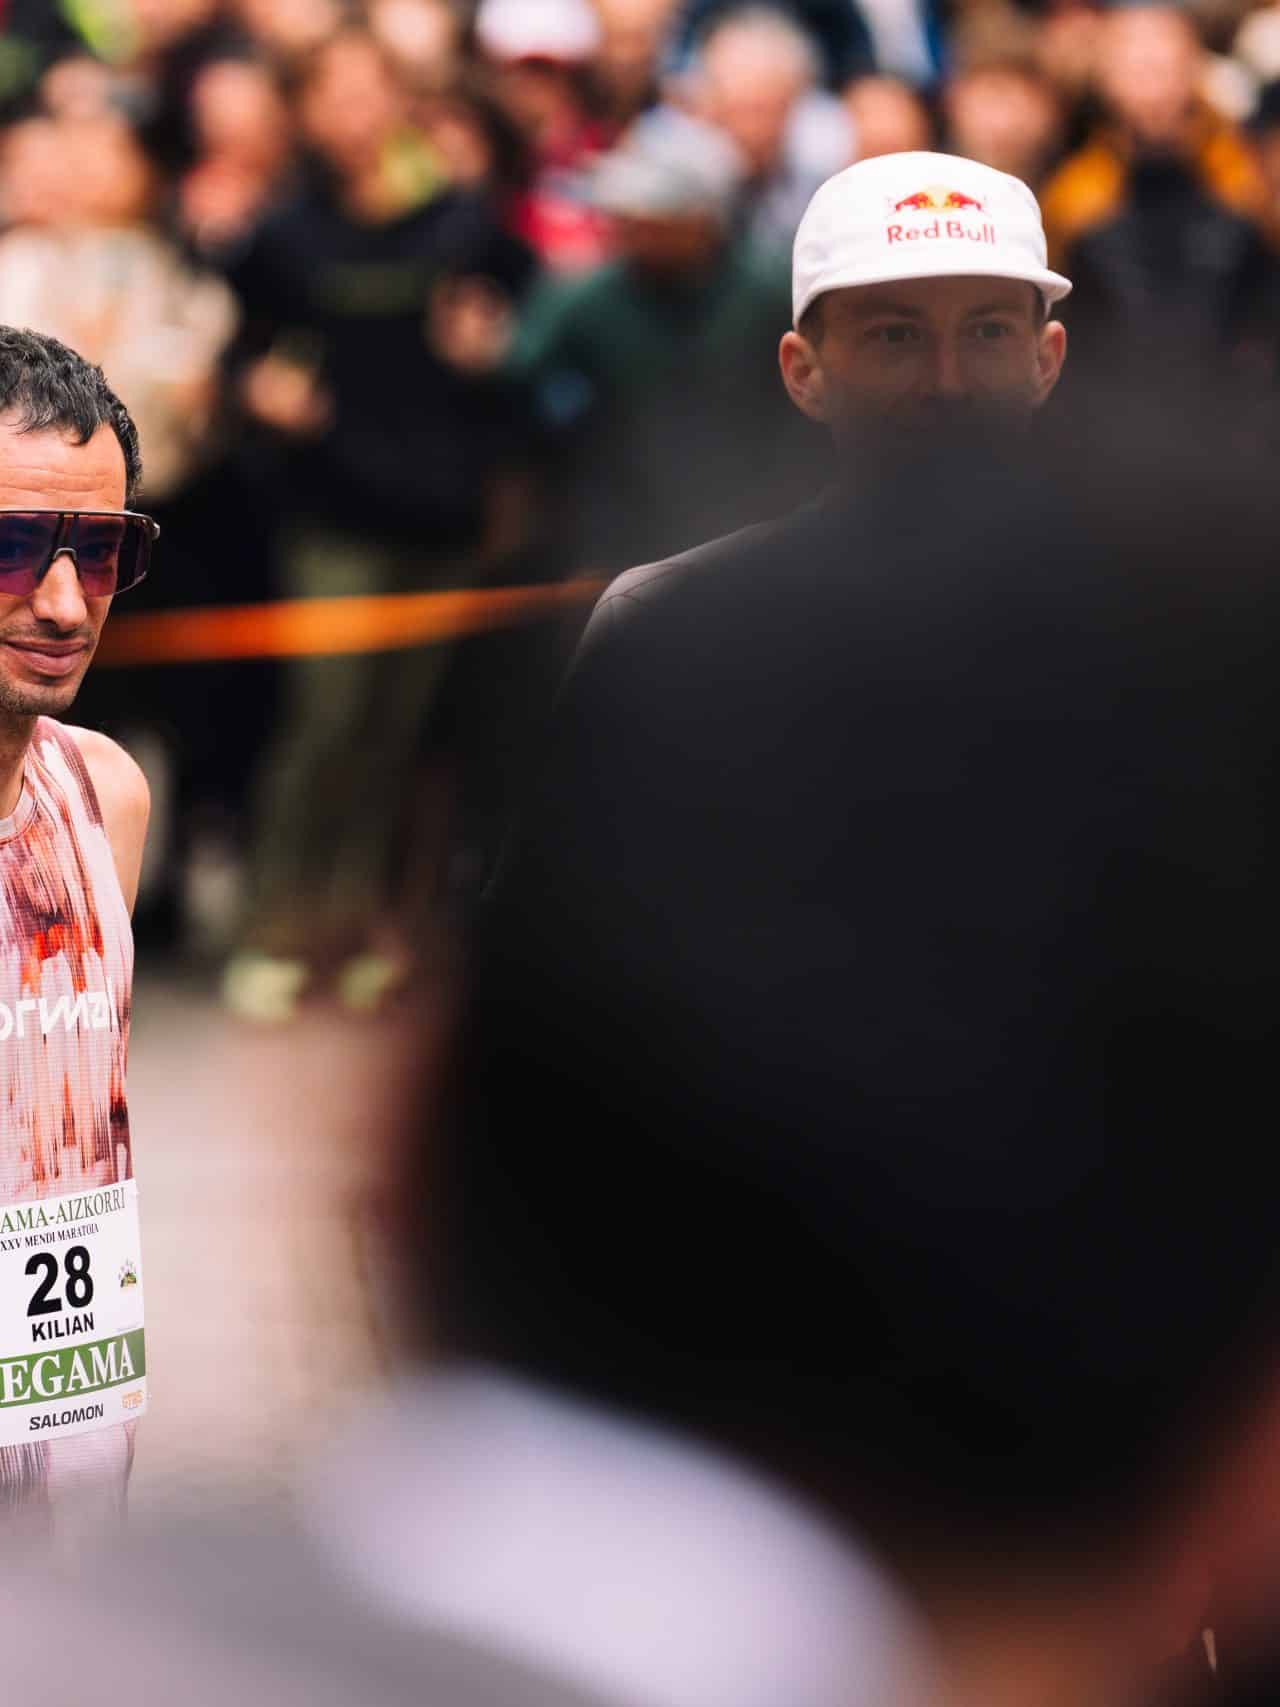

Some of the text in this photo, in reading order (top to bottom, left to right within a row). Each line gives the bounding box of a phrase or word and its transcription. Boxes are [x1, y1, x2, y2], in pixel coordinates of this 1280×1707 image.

[887, 220, 996, 244] Red Bull
[0, 1223, 99, 1252] XXV MENDI MARATOIA
[24, 1245, 94, 1317] 28
[31, 1312, 95, 1342] KILIAN
[29, 1403, 104, 1431] SALOMON
